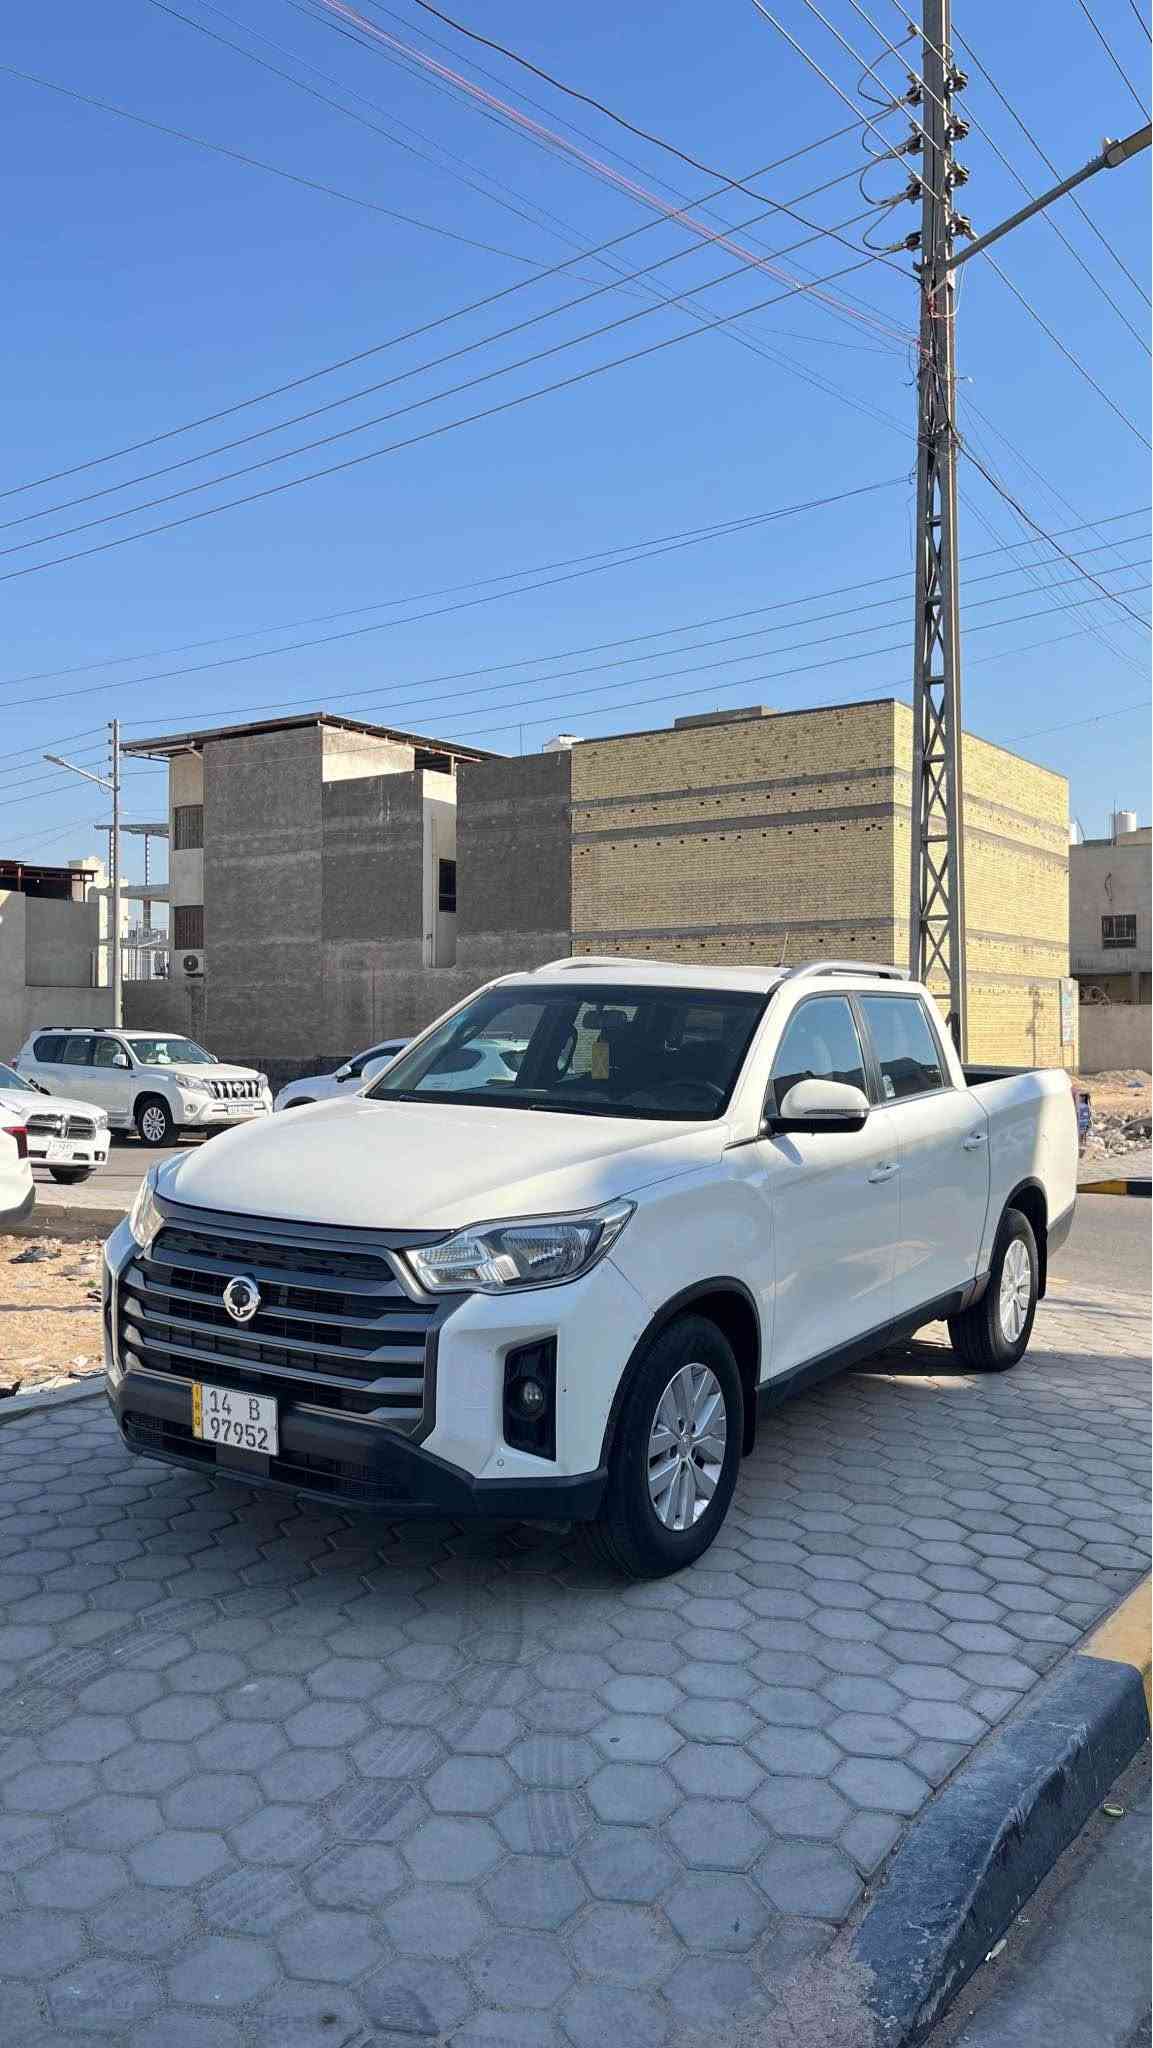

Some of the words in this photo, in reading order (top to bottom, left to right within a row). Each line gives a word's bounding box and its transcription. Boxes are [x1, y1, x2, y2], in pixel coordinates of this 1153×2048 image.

[210, 1391, 232, 1415] 14
[249, 1398, 260, 1420] B
[210, 1416, 269, 1451] 97952
